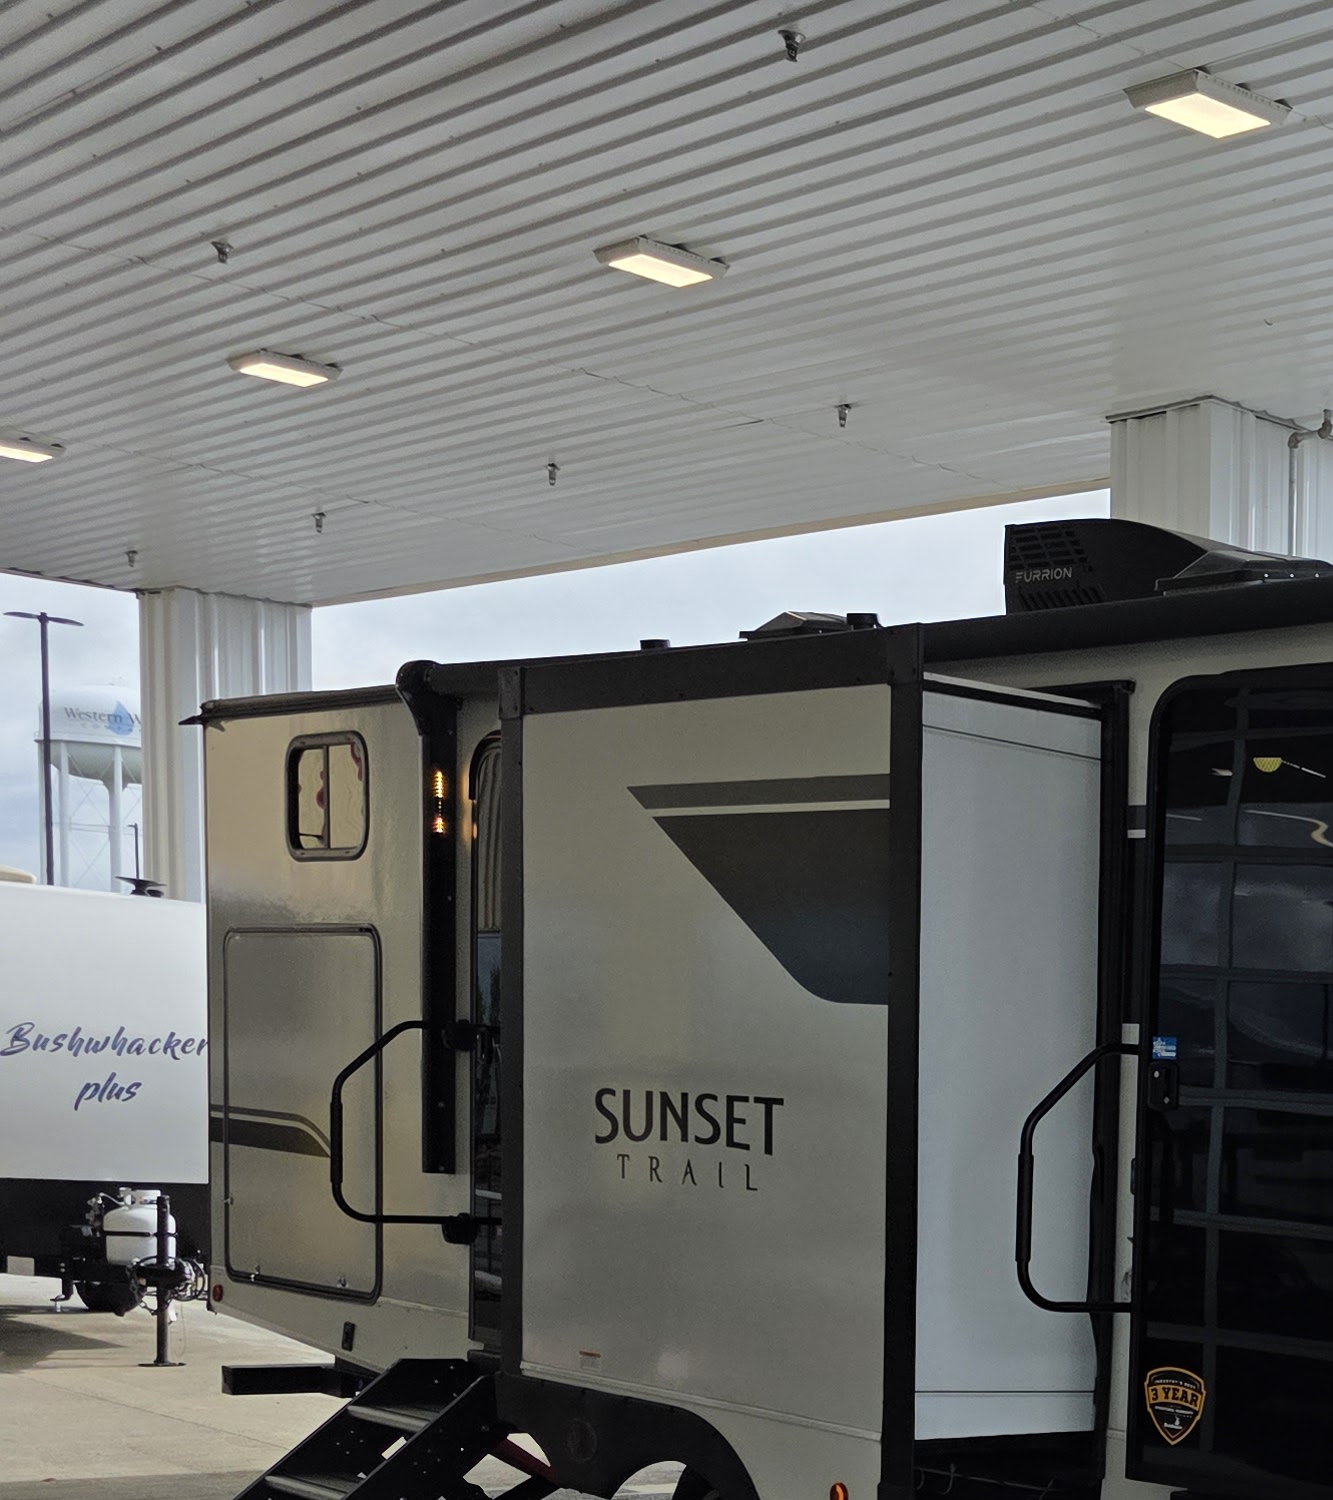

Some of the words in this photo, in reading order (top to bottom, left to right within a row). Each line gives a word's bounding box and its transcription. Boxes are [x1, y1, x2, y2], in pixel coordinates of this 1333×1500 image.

[1015, 566, 1073, 583] FURRION
[64, 706, 123, 723] Western
[0, 1022, 208, 1060] Bushwhacker
[74, 1071, 142, 1111] plus
[595, 1087, 785, 1156] SUNSET
[617, 1153, 758, 1191] TRAIL
[1151, 1387, 1159, 1401] 3
[1162, 1387, 1199, 1410] YEAR
